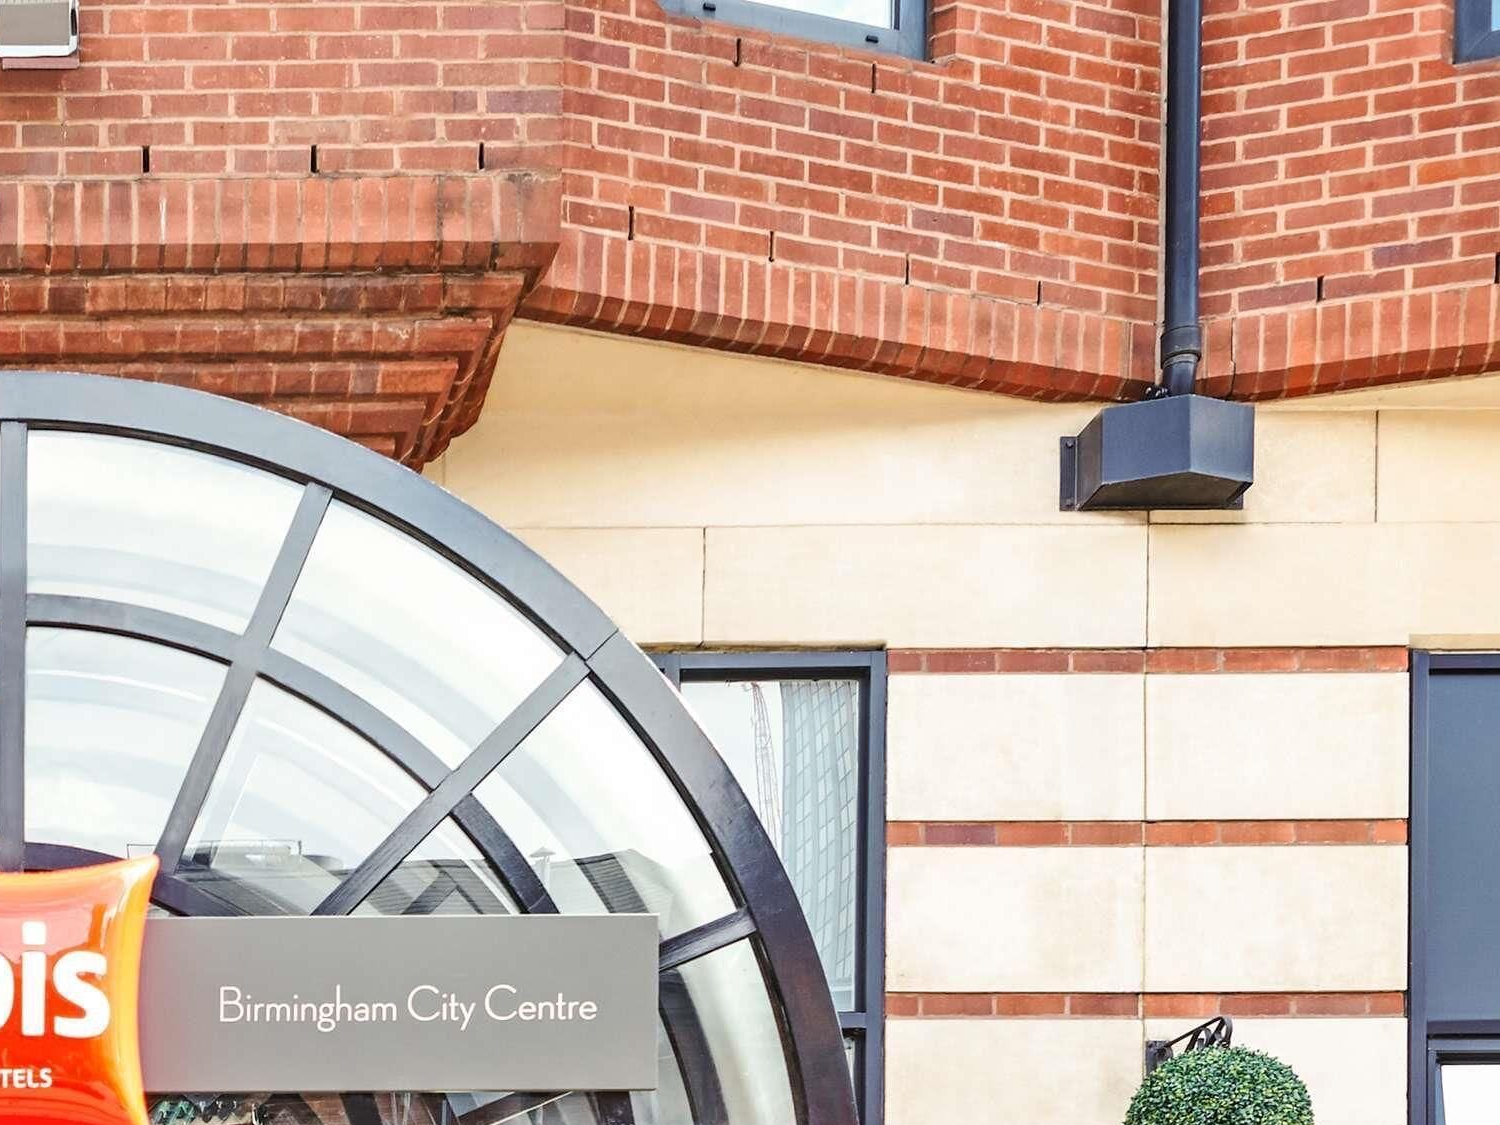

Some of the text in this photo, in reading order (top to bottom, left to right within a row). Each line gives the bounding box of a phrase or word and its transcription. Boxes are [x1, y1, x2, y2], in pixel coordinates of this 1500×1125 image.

[219, 984, 598, 1032] Birmingham City Centre
